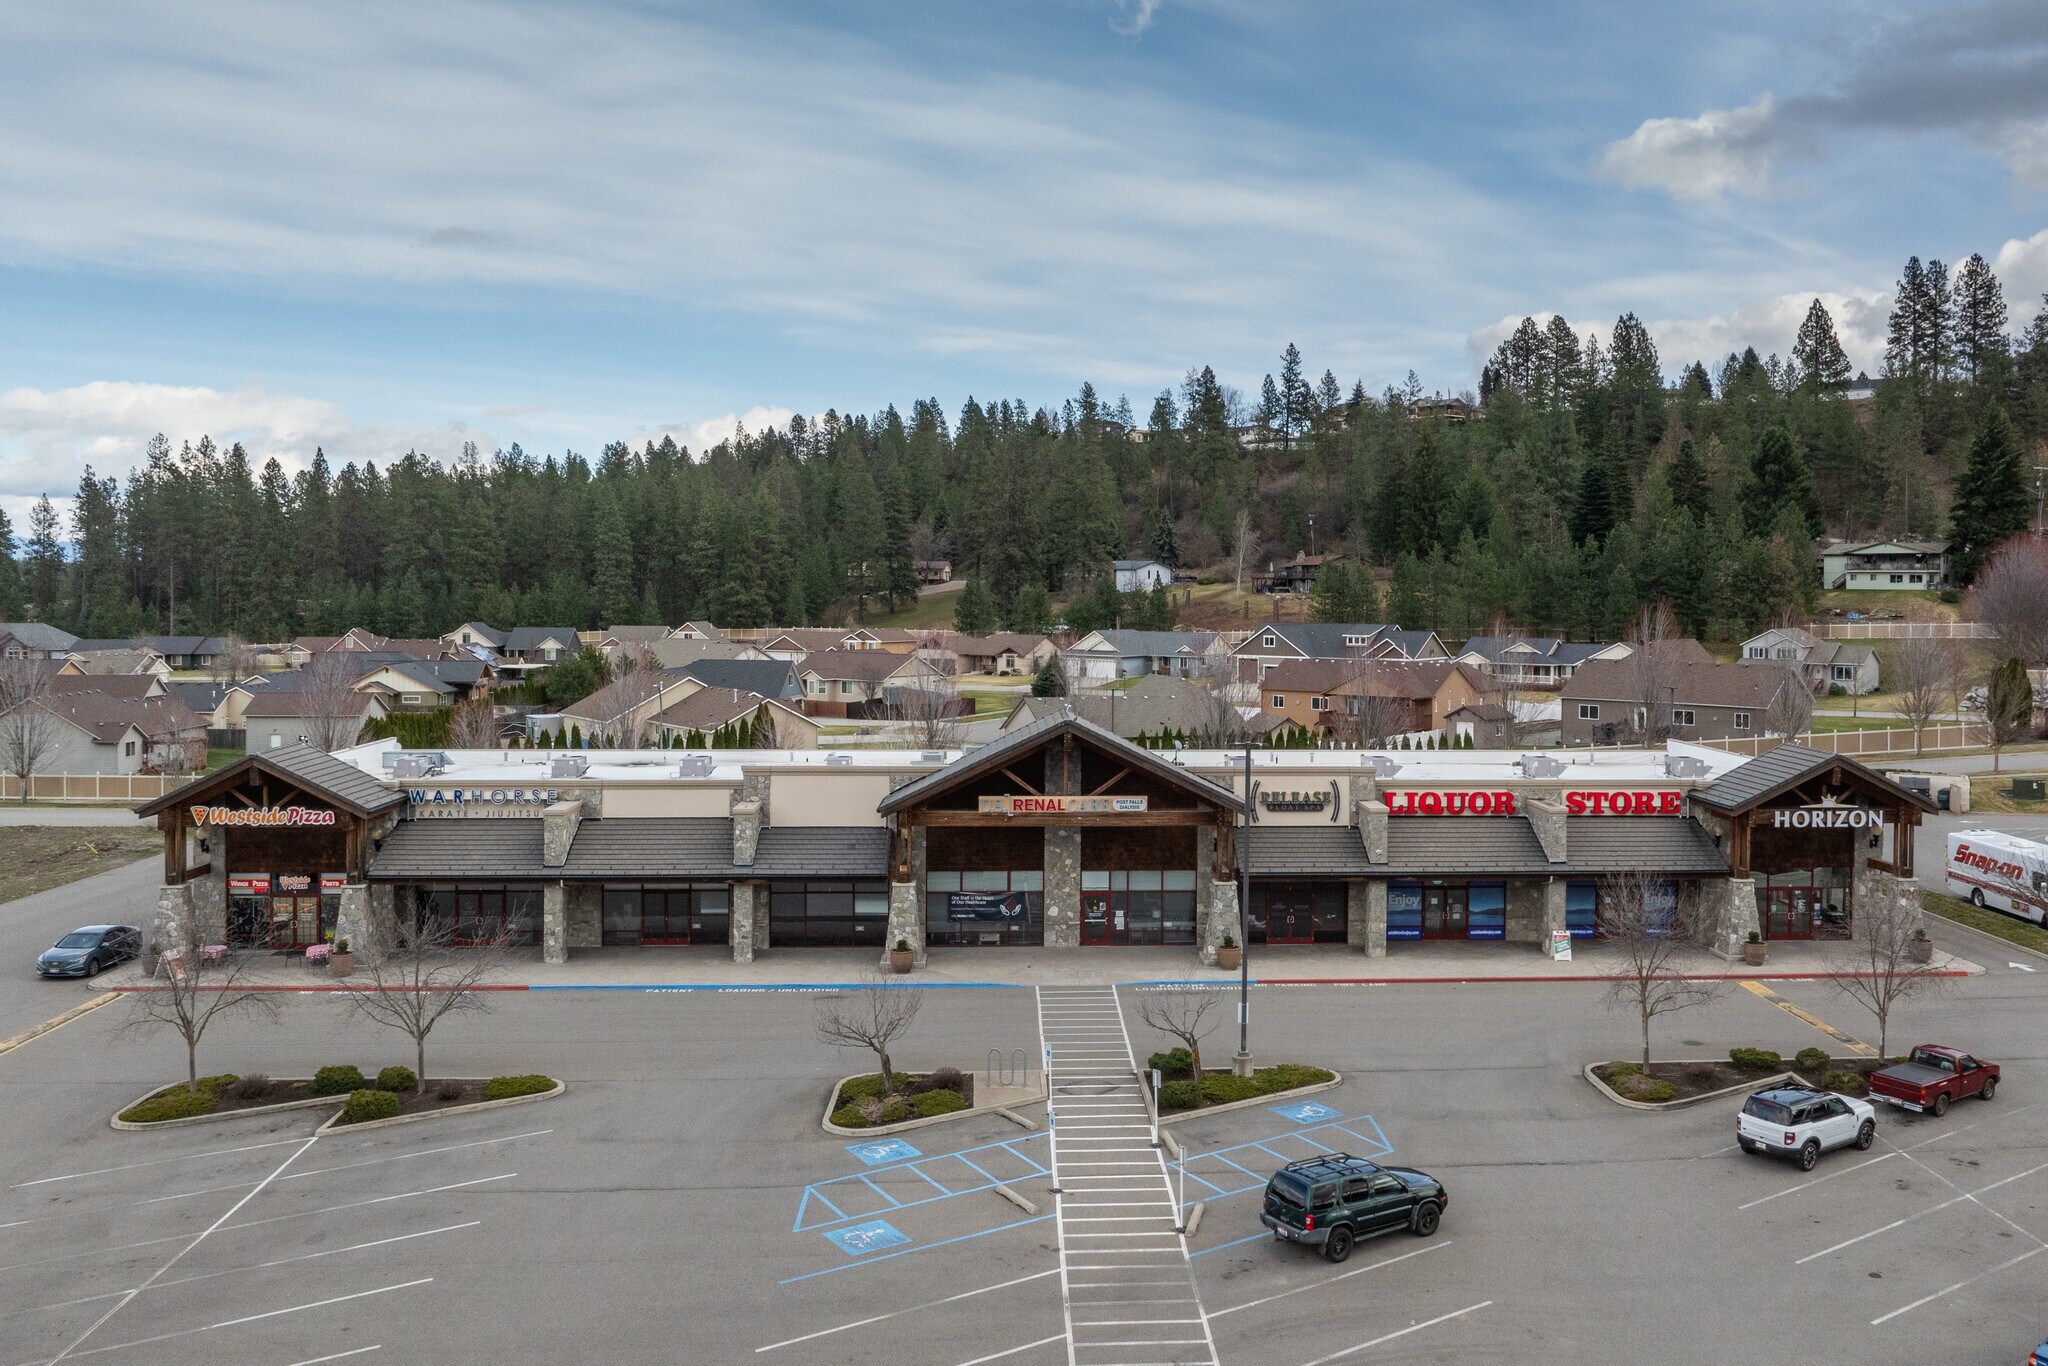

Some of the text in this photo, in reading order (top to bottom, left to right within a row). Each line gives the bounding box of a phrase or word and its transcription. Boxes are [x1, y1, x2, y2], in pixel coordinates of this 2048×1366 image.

[409, 788, 559, 804] WARHORSE
[1260, 791, 1331, 804] RELEASE
[1383, 791, 1681, 815] LIQUOR STORE
[1013, 799, 1066, 811] RENAL
[1774, 810, 1884, 828] HORIZON
[1953, 843, 2024, 880] Snap-on
[1388, 894, 1420, 907] Enjoy
